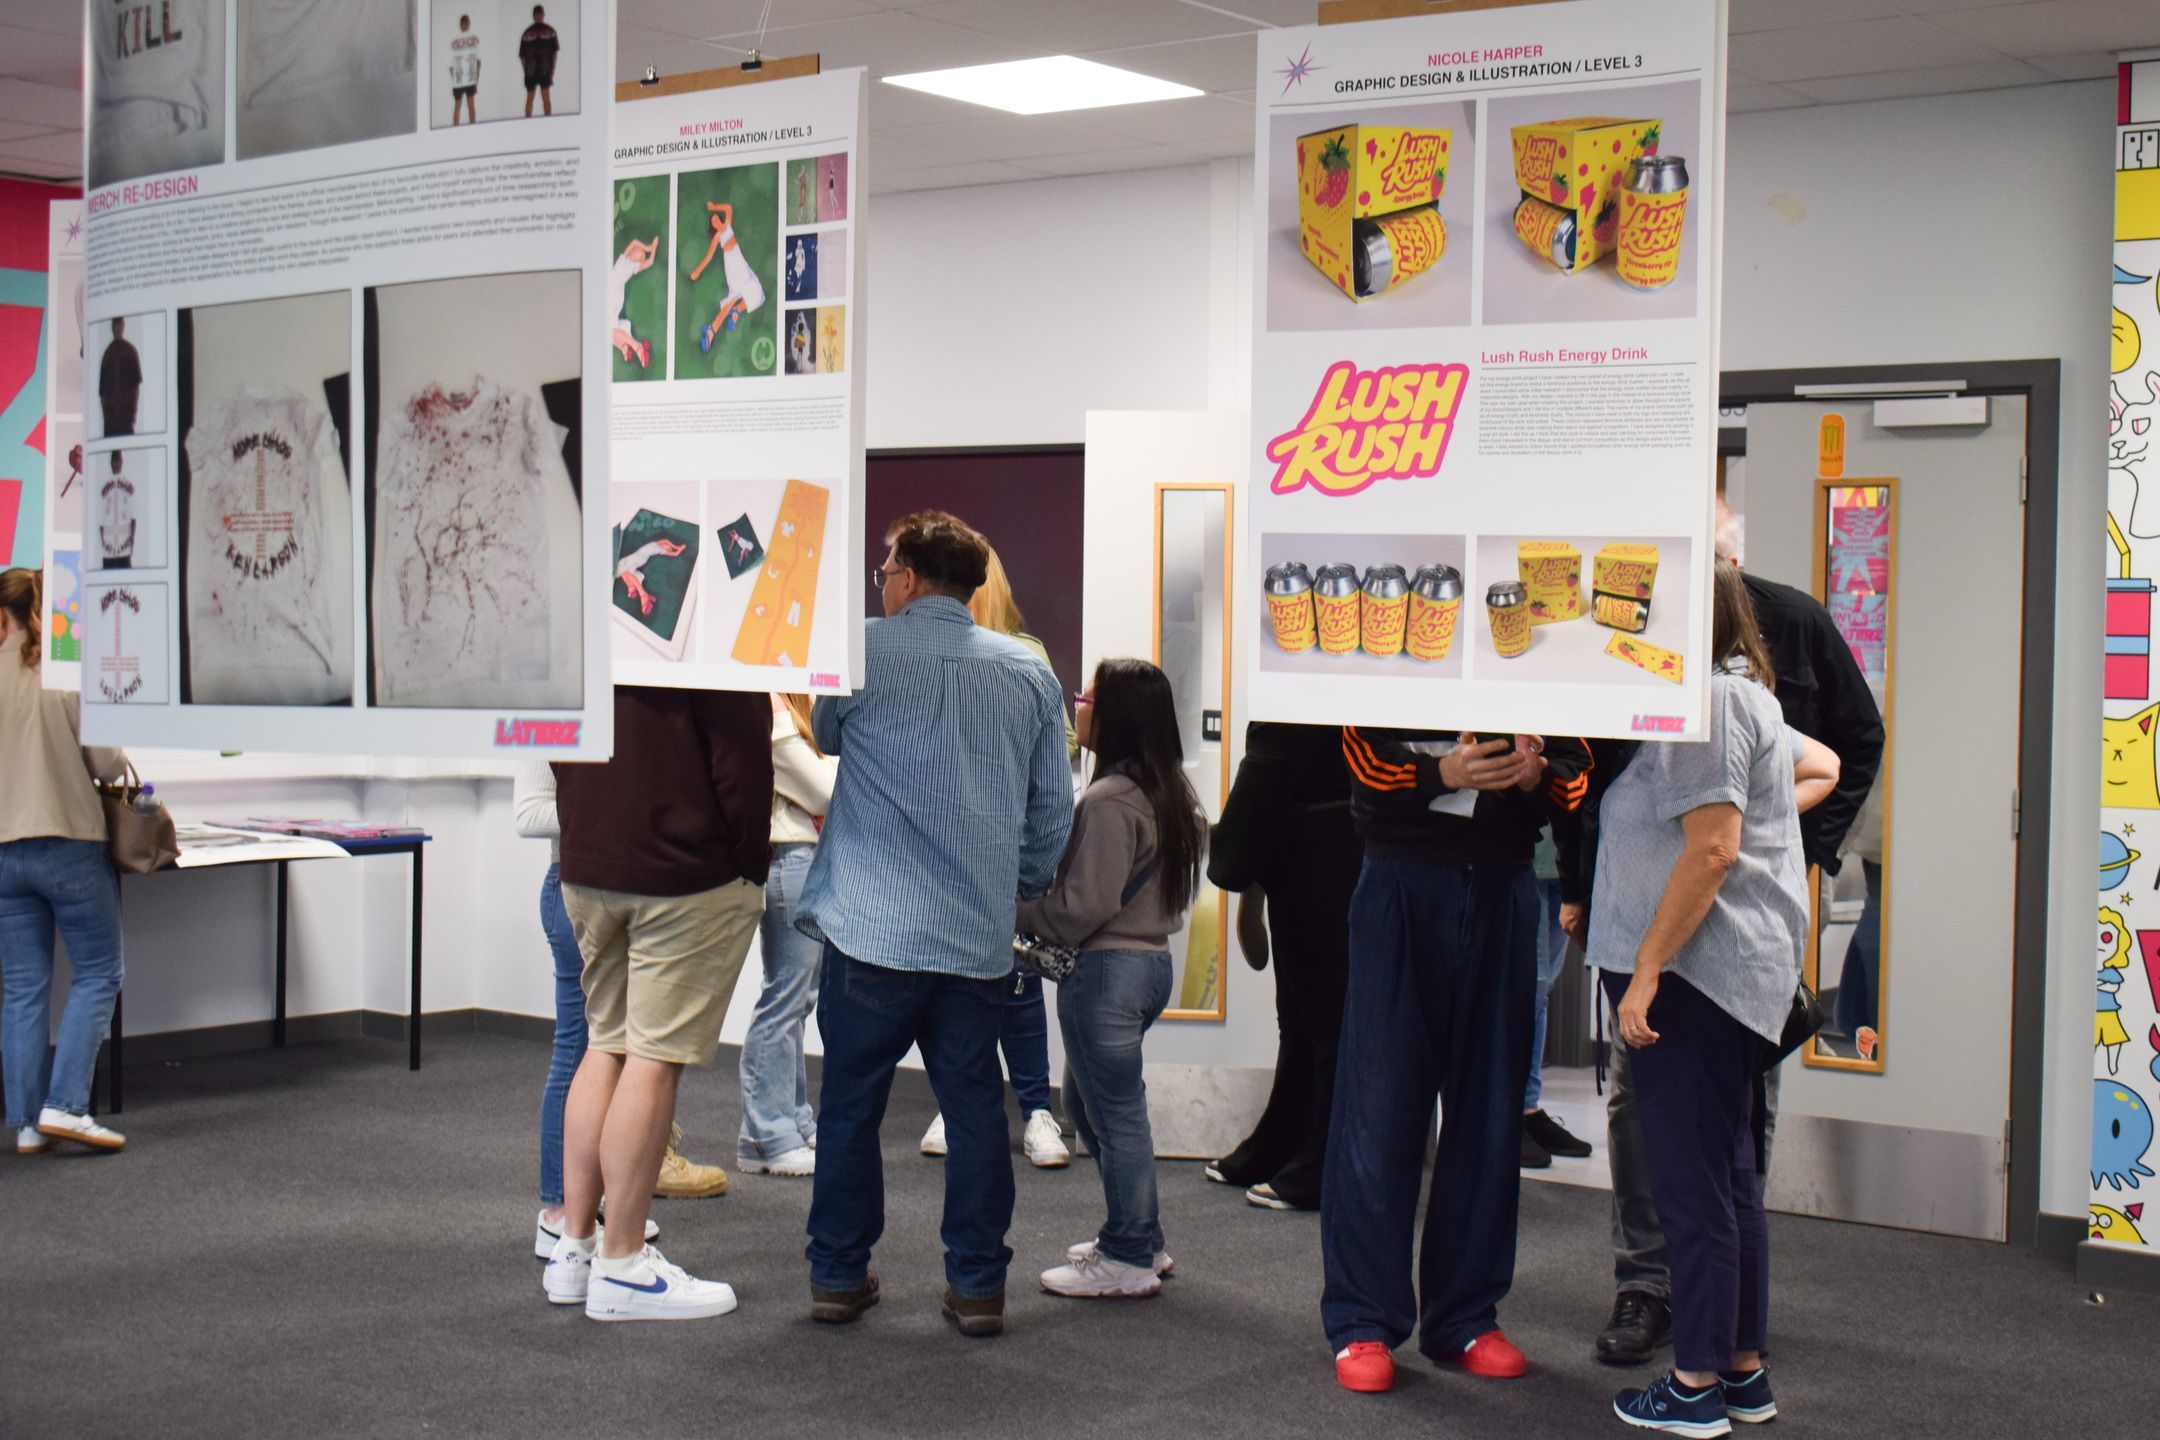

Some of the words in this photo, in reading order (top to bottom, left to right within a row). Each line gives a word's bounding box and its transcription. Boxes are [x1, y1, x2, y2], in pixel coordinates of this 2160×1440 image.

[116, 0, 183, 61] KILL
[1334, 76, 1396, 94] GRAPHIC
[1399, 71, 1452, 88] DESIGN
[1456, 70, 1465, 83] &
[1469, 61, 1572, 82] ILLUSTRATION
[1575, 60, 1581, 73] /
[1584, 55, 1631, 73] LEVEL
[1634, 54, 1643, 68] 3
[1427, 50, 1479, 67] NICOLE
[1483, 44, 1543, 62] HARPER
[614, 144, 655, 160] GRAPHIC
[656, 140, 690, 155] DESIGN
[692, 139, 699, 150] &
[701, 131, 768, 149] ILLUSTRATION
[774, 126, 804, 140] LEVEL
[806, 125, 812, 137] 3
[679, 124, 706, 137] MILEY
[709, 118, 744, 133] MILTON
[1395, 131, 1441, 163] LUSH
[87, 189, 121, 215] MERCH
[123, 175, 199, 205] RE-DESIGN
[1380, 157, 1437, 196] RUSH
[1481, 350, 1515, 364] Lush
[1518, 349, 1554, 363] Rush
[1558, 348, 1608, 365] Energy
[1611, 346, 1649, 361] Drink
[1298, 361, 1469, 432] LUSH
[1266, 422, 1454, 496] RUSH
